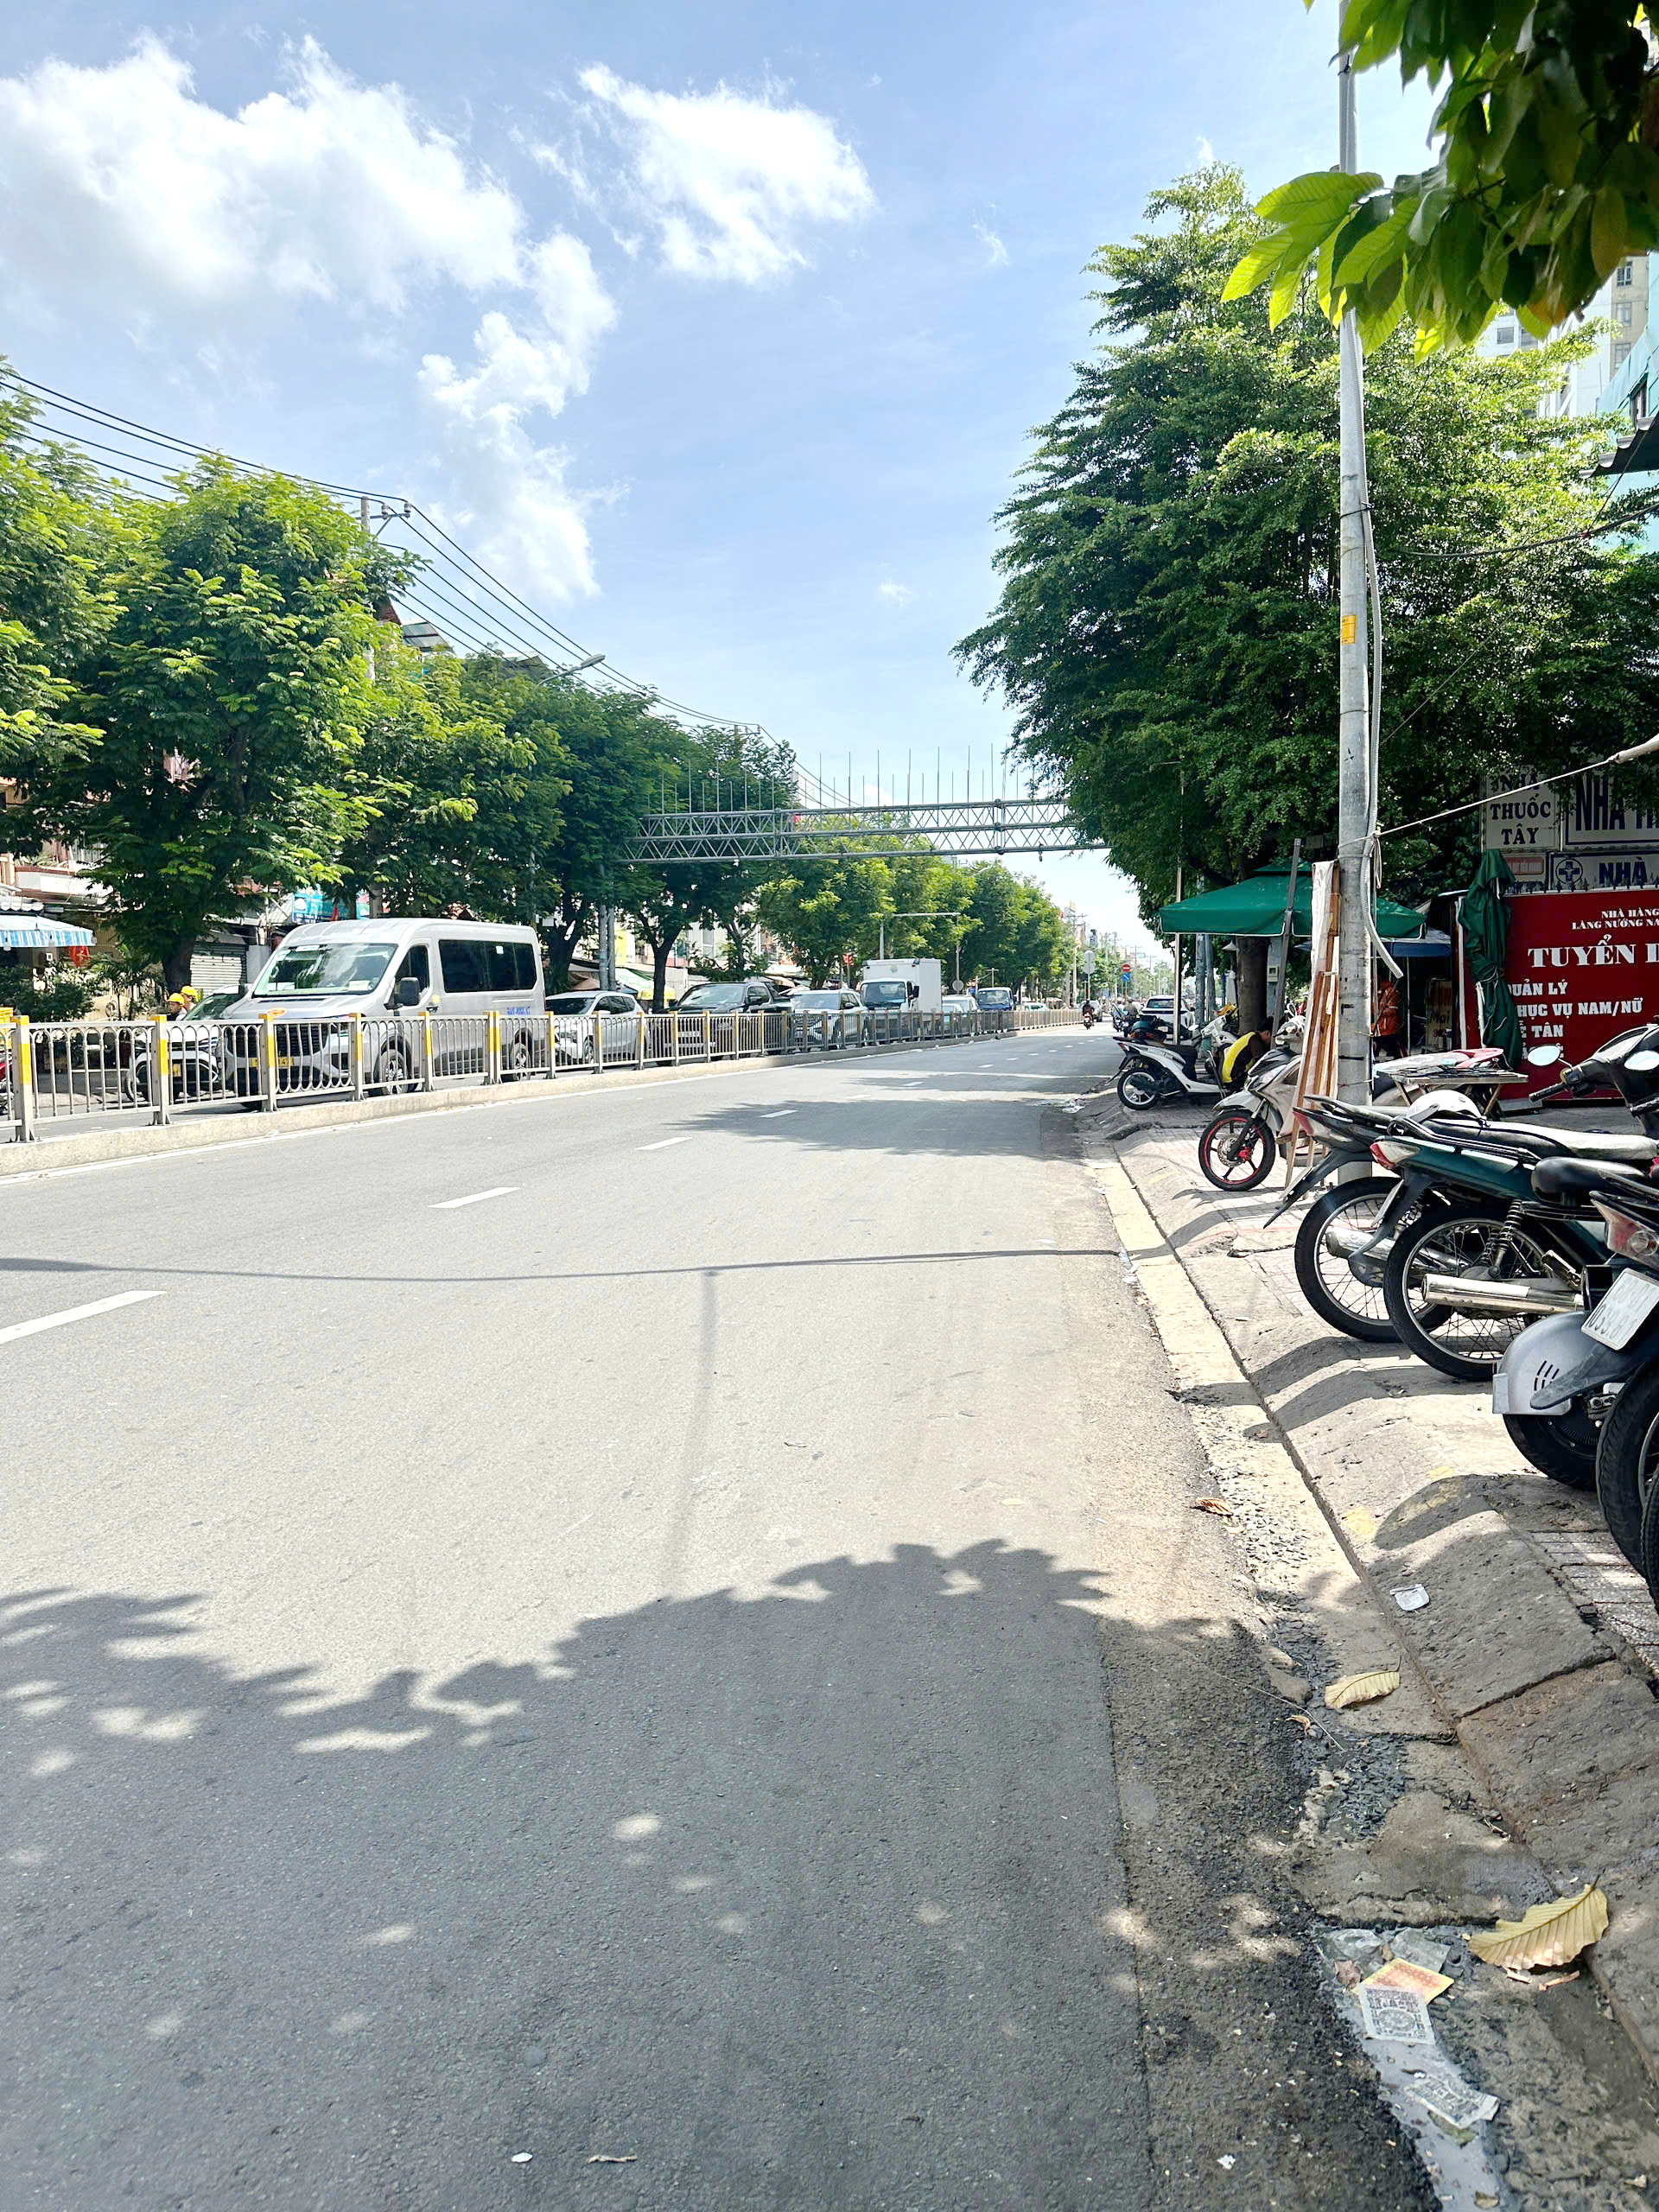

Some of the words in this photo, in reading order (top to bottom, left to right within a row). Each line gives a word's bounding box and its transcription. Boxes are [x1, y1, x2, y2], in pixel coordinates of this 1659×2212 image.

[1491, 793, 1551, 820] THUỐC
[1502, 823, 1539, 844] TÂY
[1599, 857, 1648, 886] NHÀ
[1601, 908, 1624, 918] NHÀ
[1572, 920, 1602, 930] LÀNG
[1605, 918, 1643, 929] NƯỚNG
[1528, 934, 1636, 968] TUYỂN
[1508, 979, 1543, 996] UẢN
[1548, 979, 1567, 995] LÝ
[1552, 1002, 1573, 1019] VỤ
[1578, 997, 1643, 1017] NAM/NỮ
[1531, 1022, 1564, 1038] TÂN
